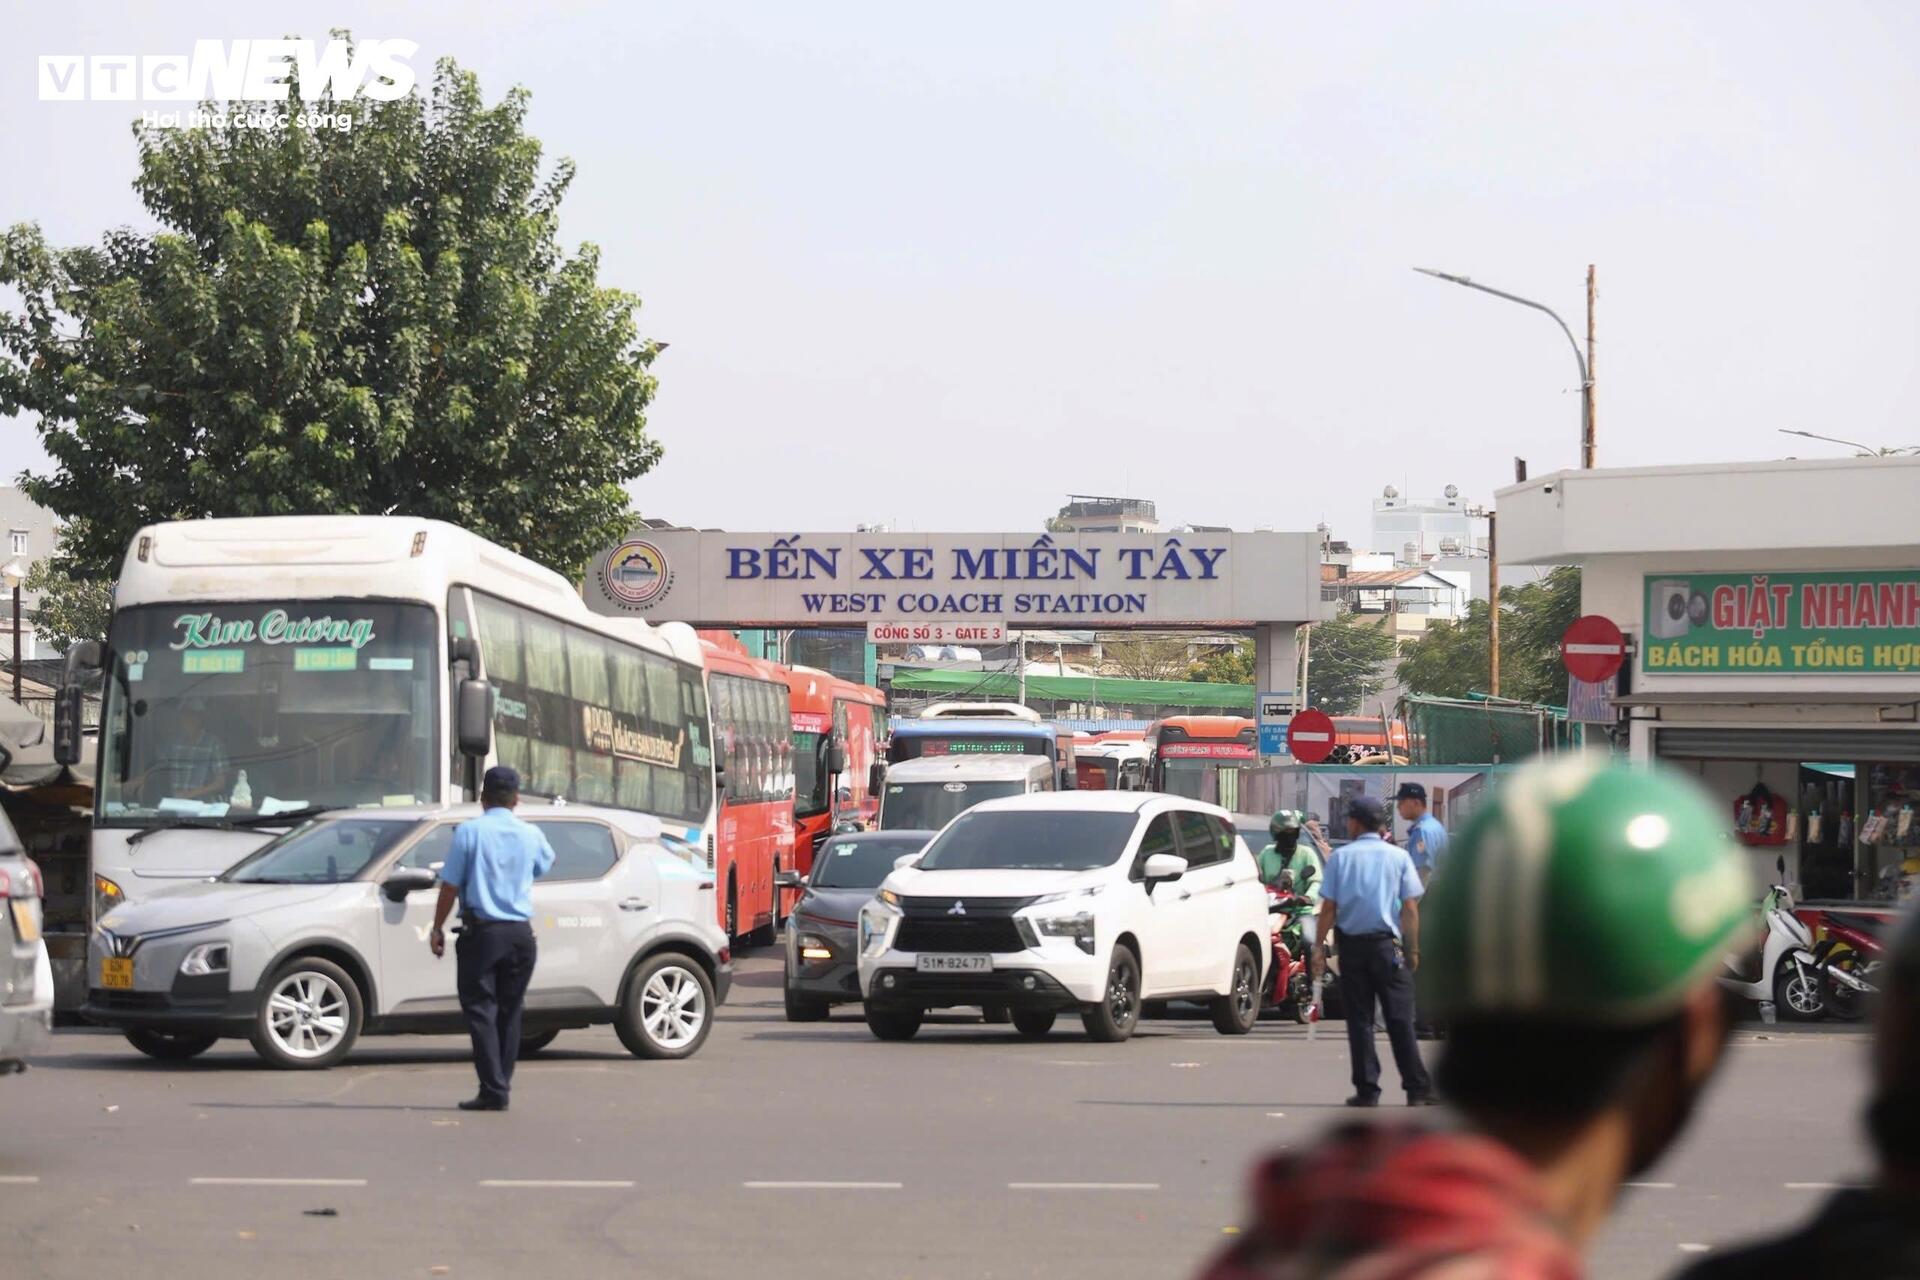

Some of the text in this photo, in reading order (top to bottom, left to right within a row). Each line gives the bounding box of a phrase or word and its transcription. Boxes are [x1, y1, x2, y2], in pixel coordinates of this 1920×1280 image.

[726, 534, 1227, 580] BẾN XE MIỀN TÂY
[801, 593, 1147, 613] WEST COACH STATION
[1712, 575, 1792, 639] GIẶT
[169, 608, 375, 650] Kim Cương
[874, 622, 909, 640] CỔNG
[913, 623, 930, 640] SỐ
[935, 627, 943, 639] 3
[955, 627, 988, 640] GATE
[992, 627, 1001, 639] 3
[1648, 642, 1719, 667] BÁCH
[1728, 642, 1782, 667] HÓA
[1791, 637, 1864, 667] TỔNG
